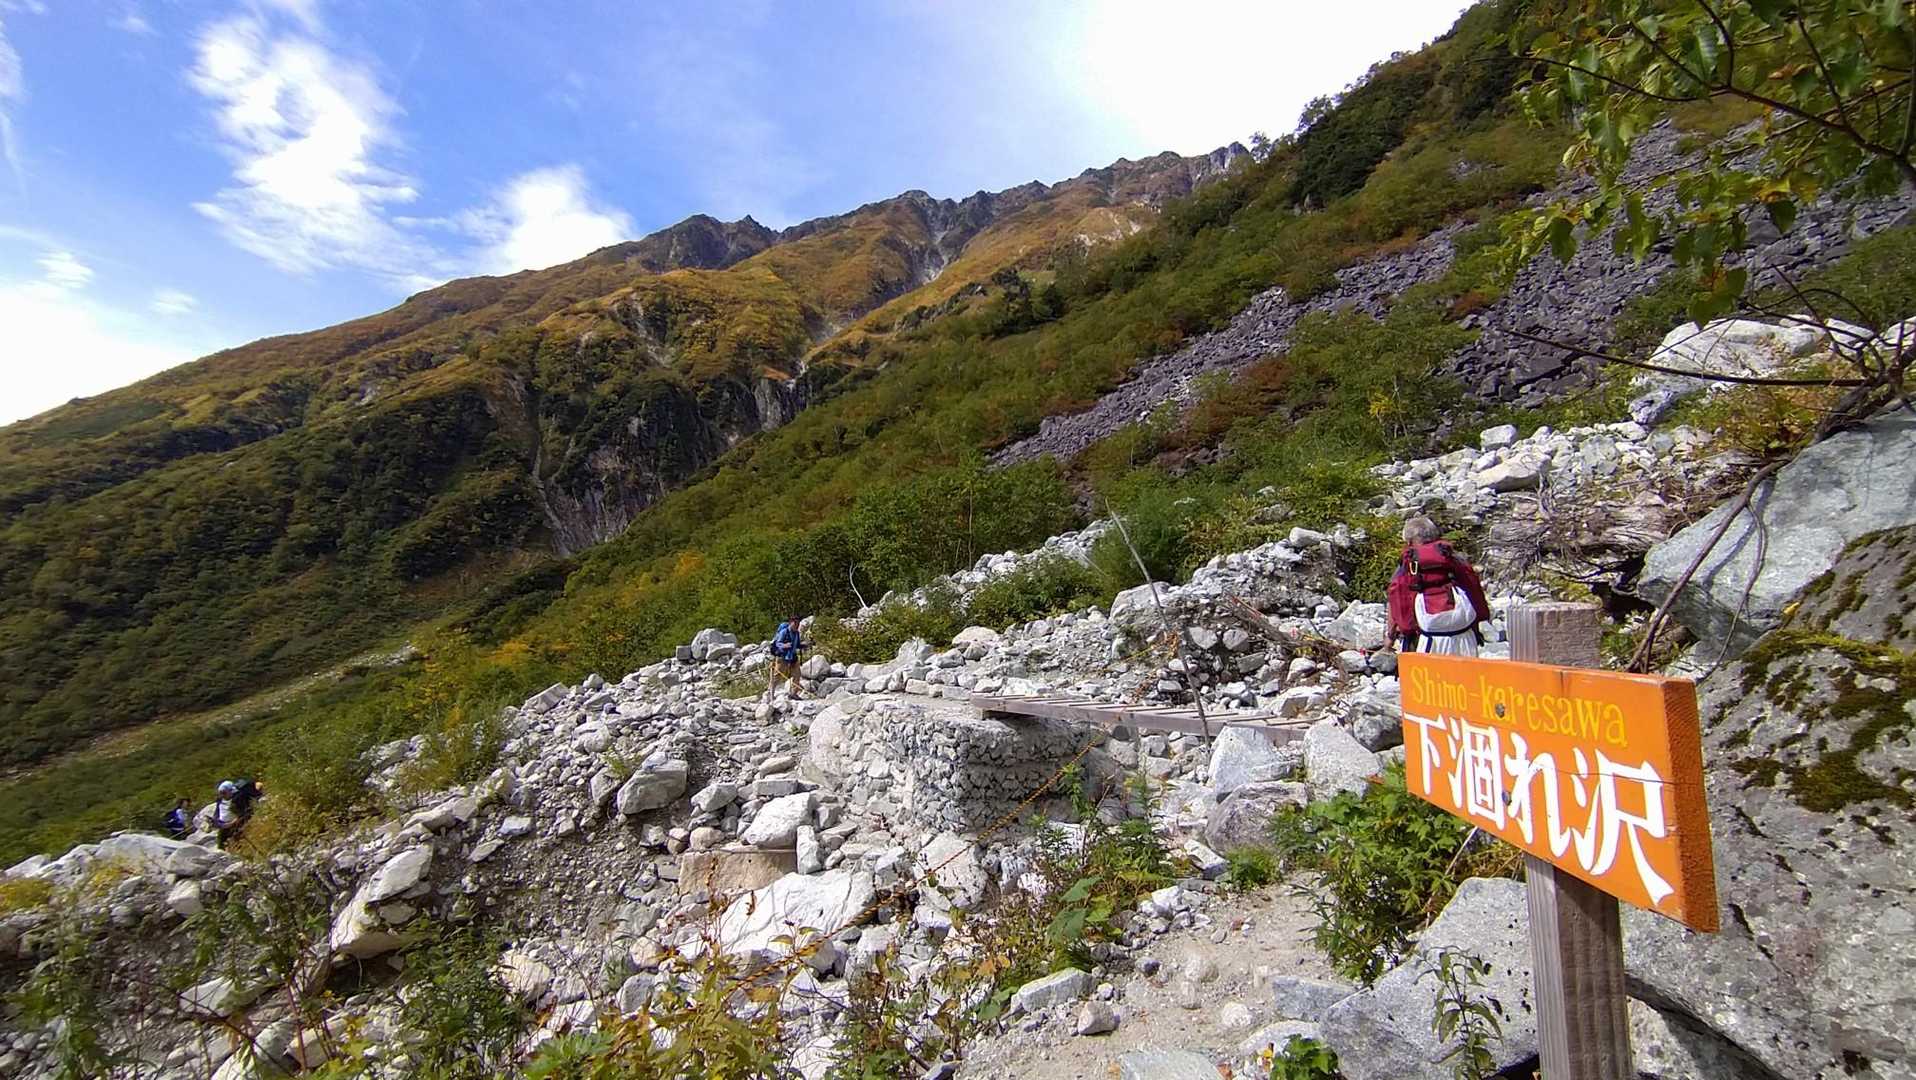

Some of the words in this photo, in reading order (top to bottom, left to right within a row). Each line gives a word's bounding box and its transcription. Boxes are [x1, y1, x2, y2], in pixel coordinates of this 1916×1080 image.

[1410, 666, 1628, 747] Shimo-karesawa
[1404, 713, 1674, 905] 下涸れ沢
